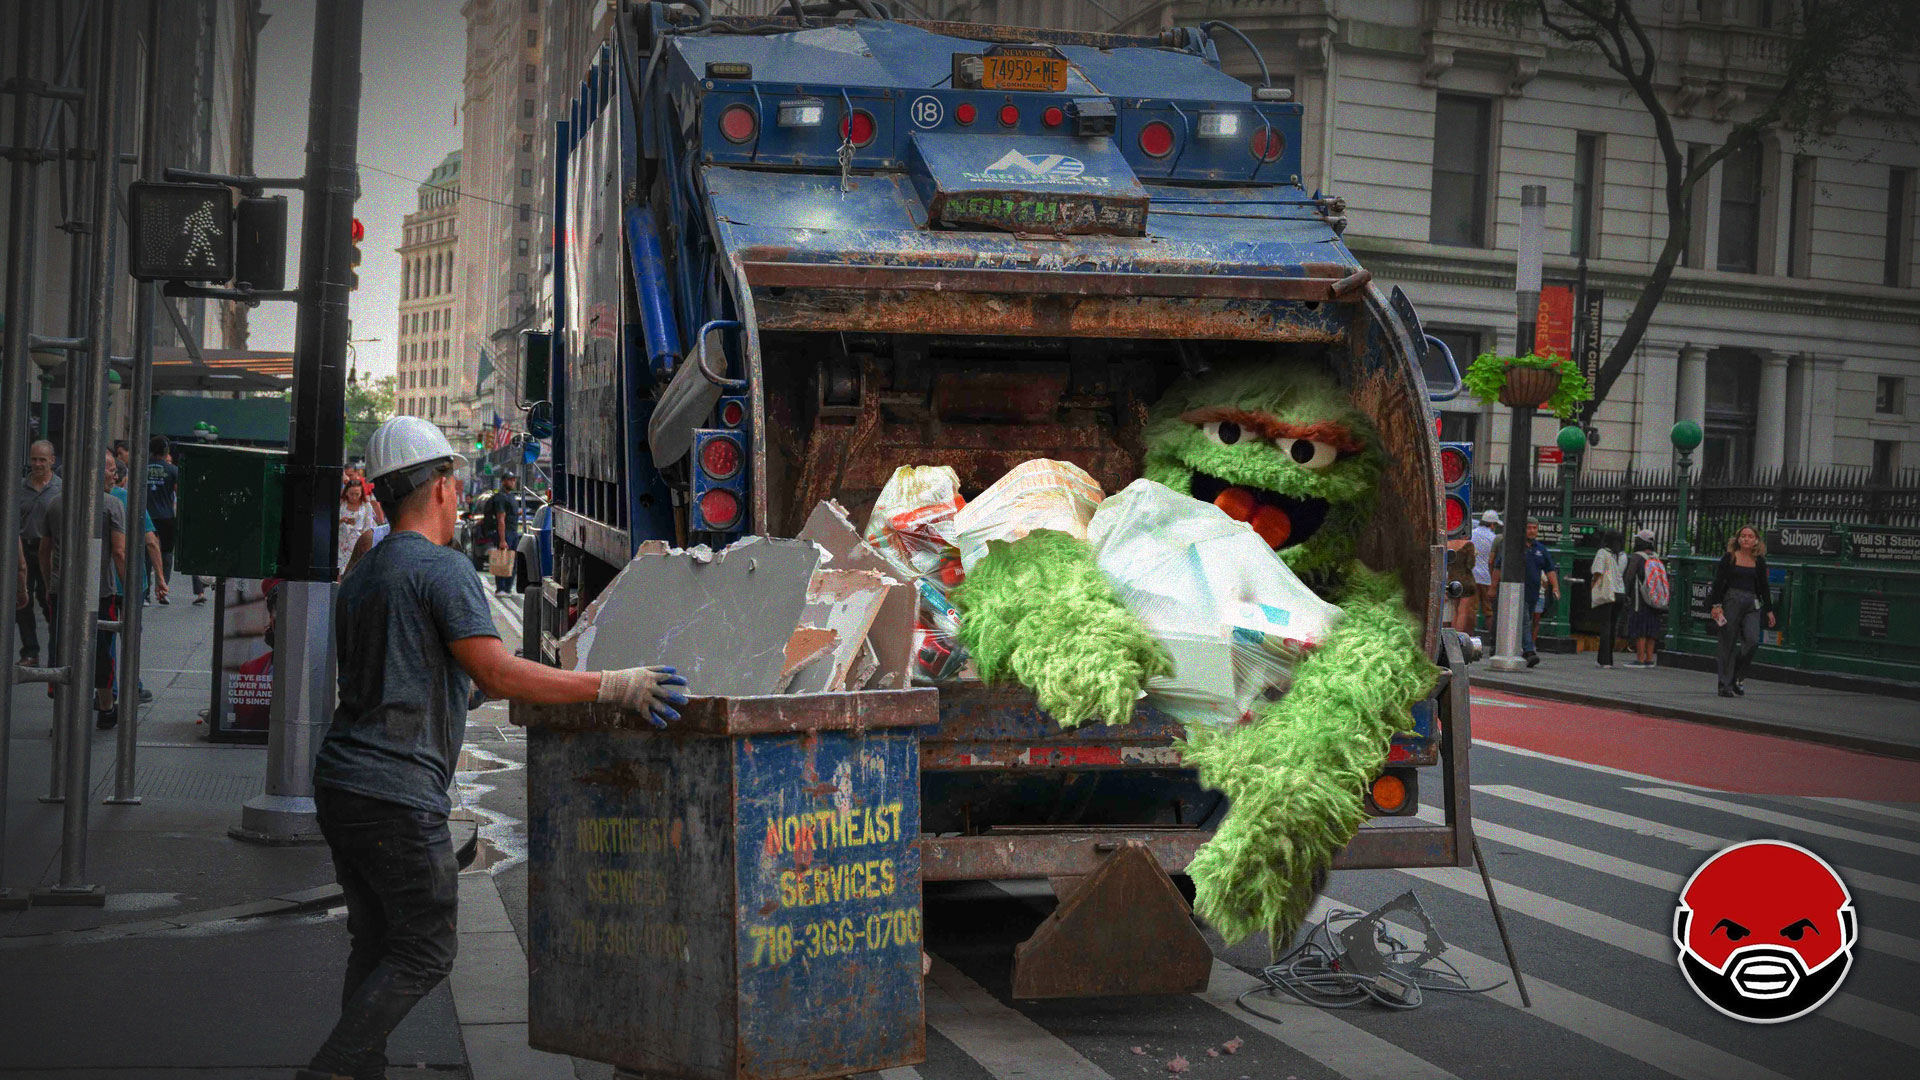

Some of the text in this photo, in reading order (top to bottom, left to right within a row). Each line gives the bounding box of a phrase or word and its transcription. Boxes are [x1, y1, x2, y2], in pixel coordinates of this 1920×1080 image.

[1003, 49, 1023, 57] NEW
[917, 102, 938, 122] 18
[1538, 302, 1549, 341] CORE
[1589, 300, 1600, 348] TRINITY
[1781, 529, 1826, 550] Subway
[1853, 533, 1873, 545] Wall
[1874, 534, 1887, 546] St
[1692, 584, 1706, 598] Wall
[576, 817, 670, 856] NORTHEAST
[766, 802, 904, 856] NORTHEAST
[779, 858, 896, 908] SERVICES
[749, 908, 921, 966] 718-366-0700
